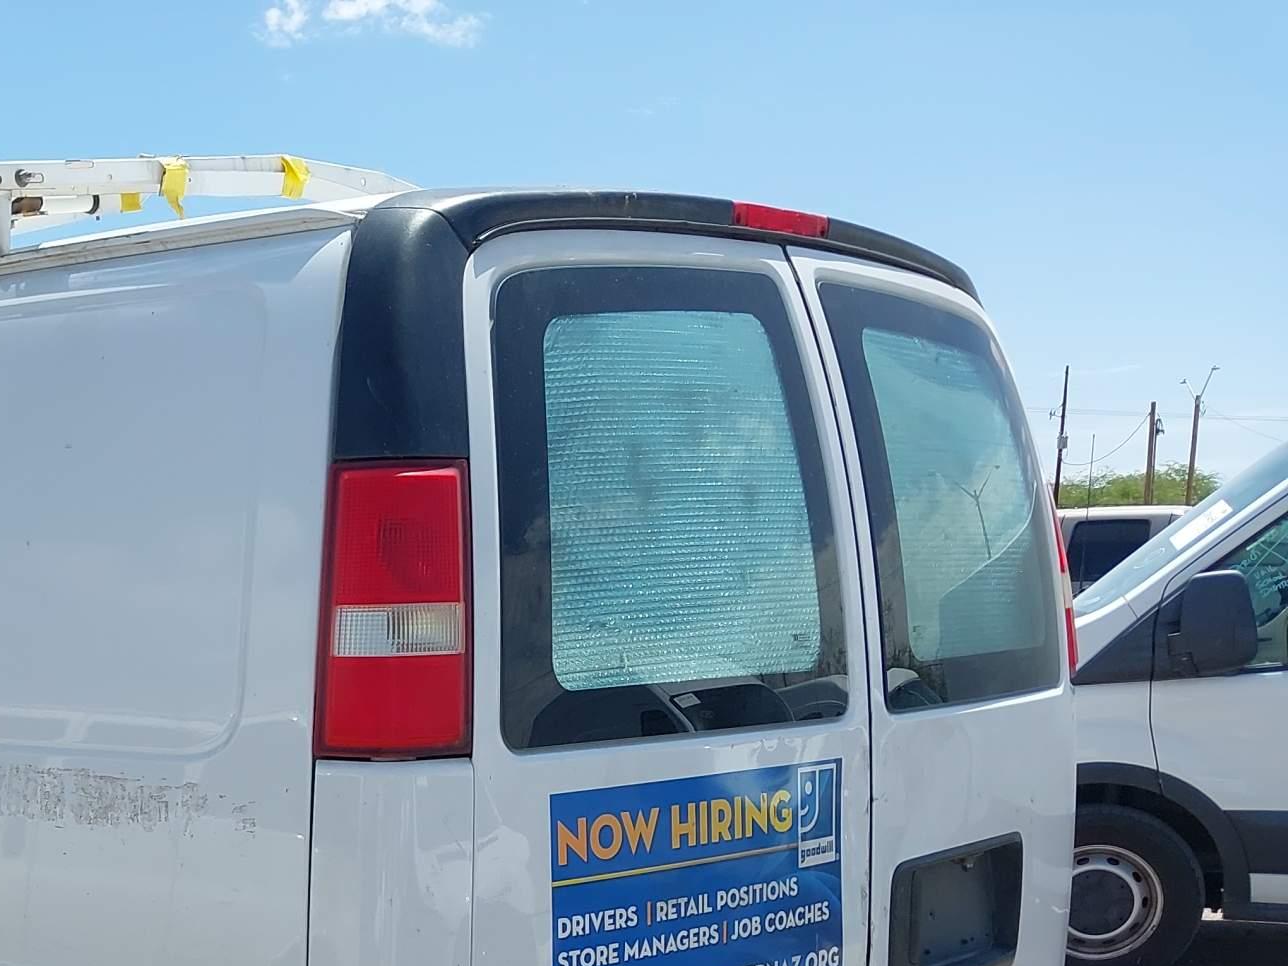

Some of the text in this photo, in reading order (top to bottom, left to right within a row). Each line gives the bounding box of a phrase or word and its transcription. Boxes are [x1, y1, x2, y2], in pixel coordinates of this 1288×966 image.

[558, 789, 793, 866] NOW HIRING
[801, 839, 834, 864] goodwill
[558, 876, 798, 939] DRIVERS RETAIL POSITIONS
[624, 924, 719, 962] MANAGERS
[731, 916, 761, 940] JOB
[765, 901, 830, 933] COACHES
